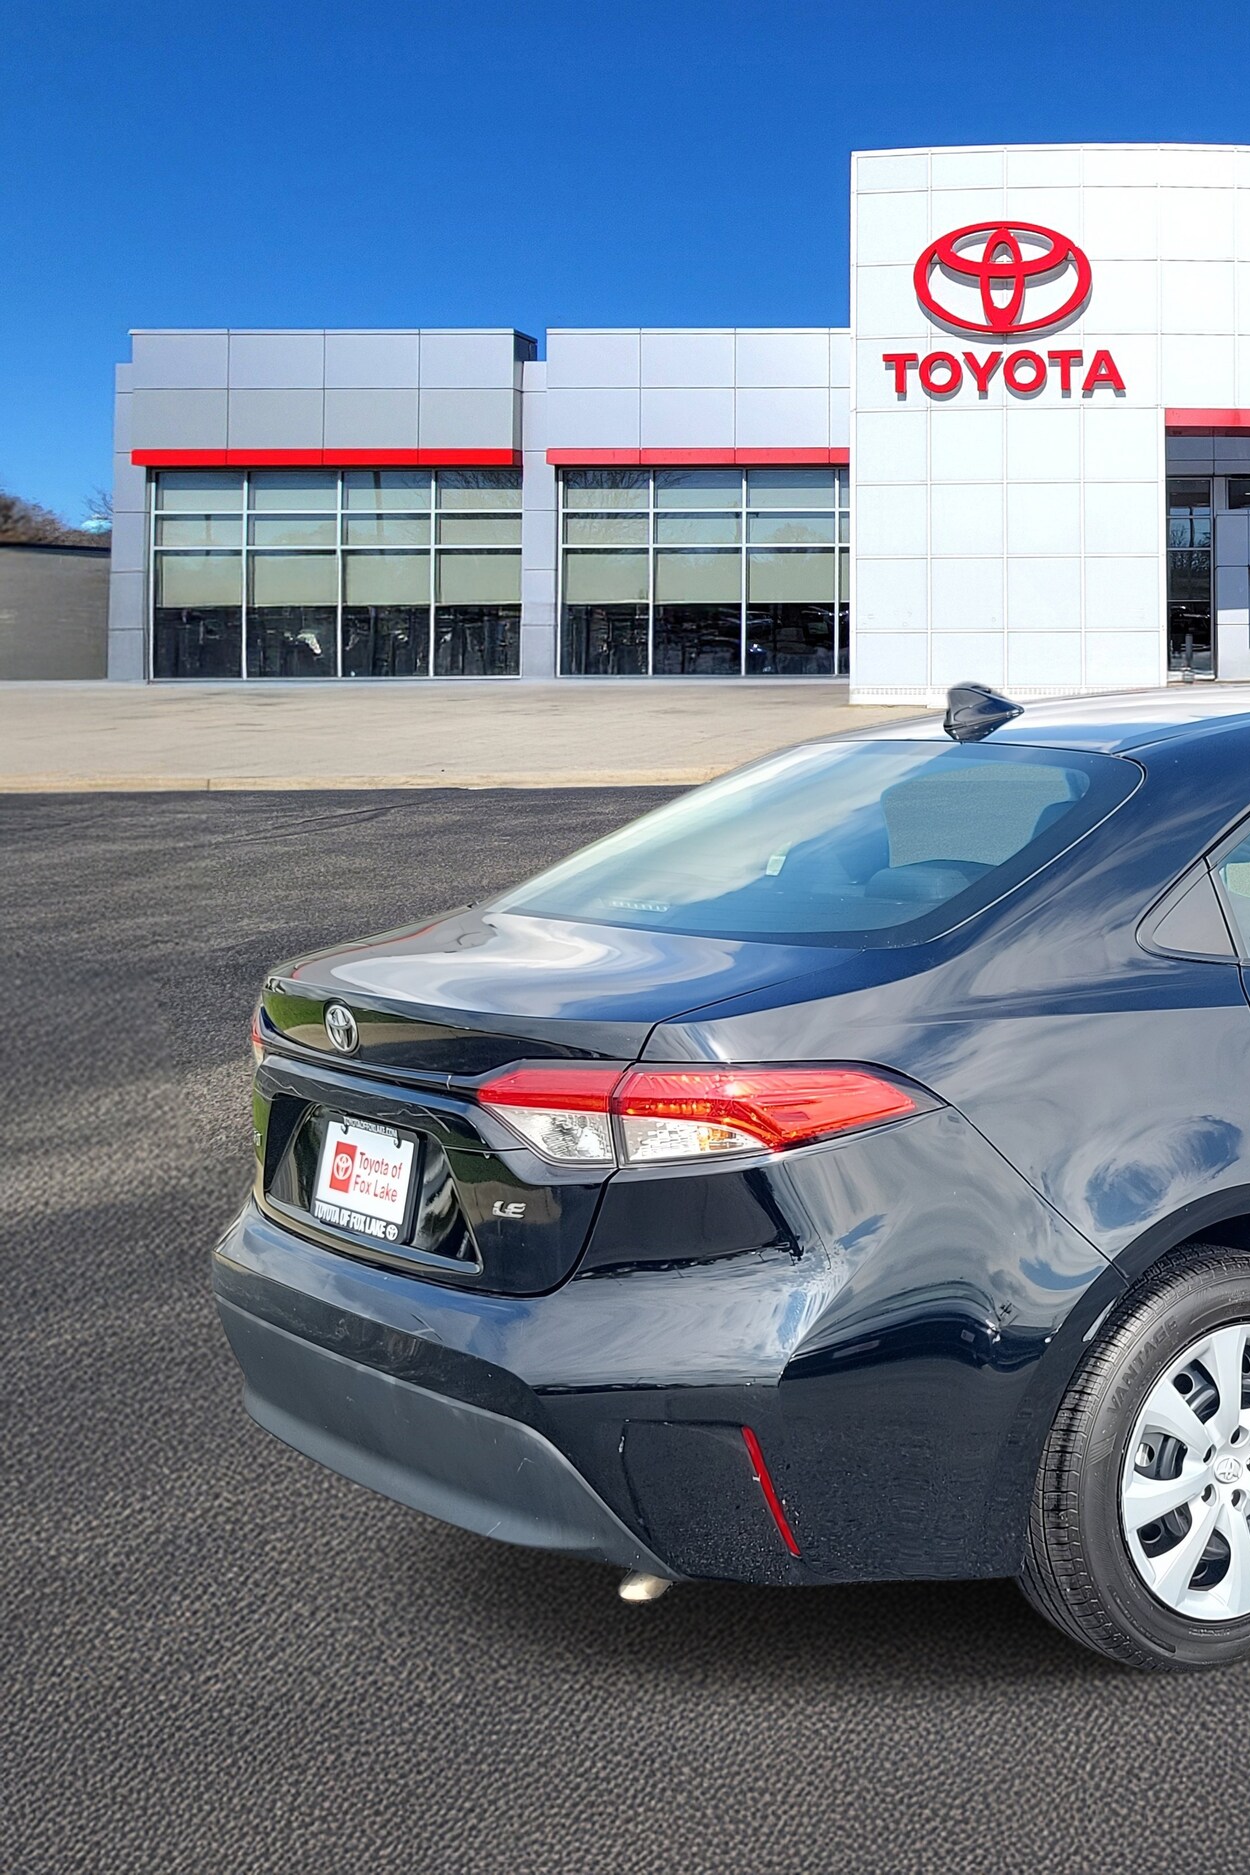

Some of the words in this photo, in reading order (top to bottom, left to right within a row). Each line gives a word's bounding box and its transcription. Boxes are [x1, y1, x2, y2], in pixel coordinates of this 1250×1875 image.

[882, 349, 1127, 397] TOYOTA
[359, 1151, 390, 1176] Toyota
[391, 1162, 403, 1180] of
[353, 1174, 372, 1195] Fox
[373, 1179, 398, 1203] Lake
[314, 1200, 341, 1224] TOYOTA
[339, 1208, 351, 1227] OF
[349, 1211, 367, 1233] FOX
[364, 1216, 387, 1239] LAKE
[492, 1200, 527, 1219] LE
[1107, 1314, 1180, 1416] VANTAGE
